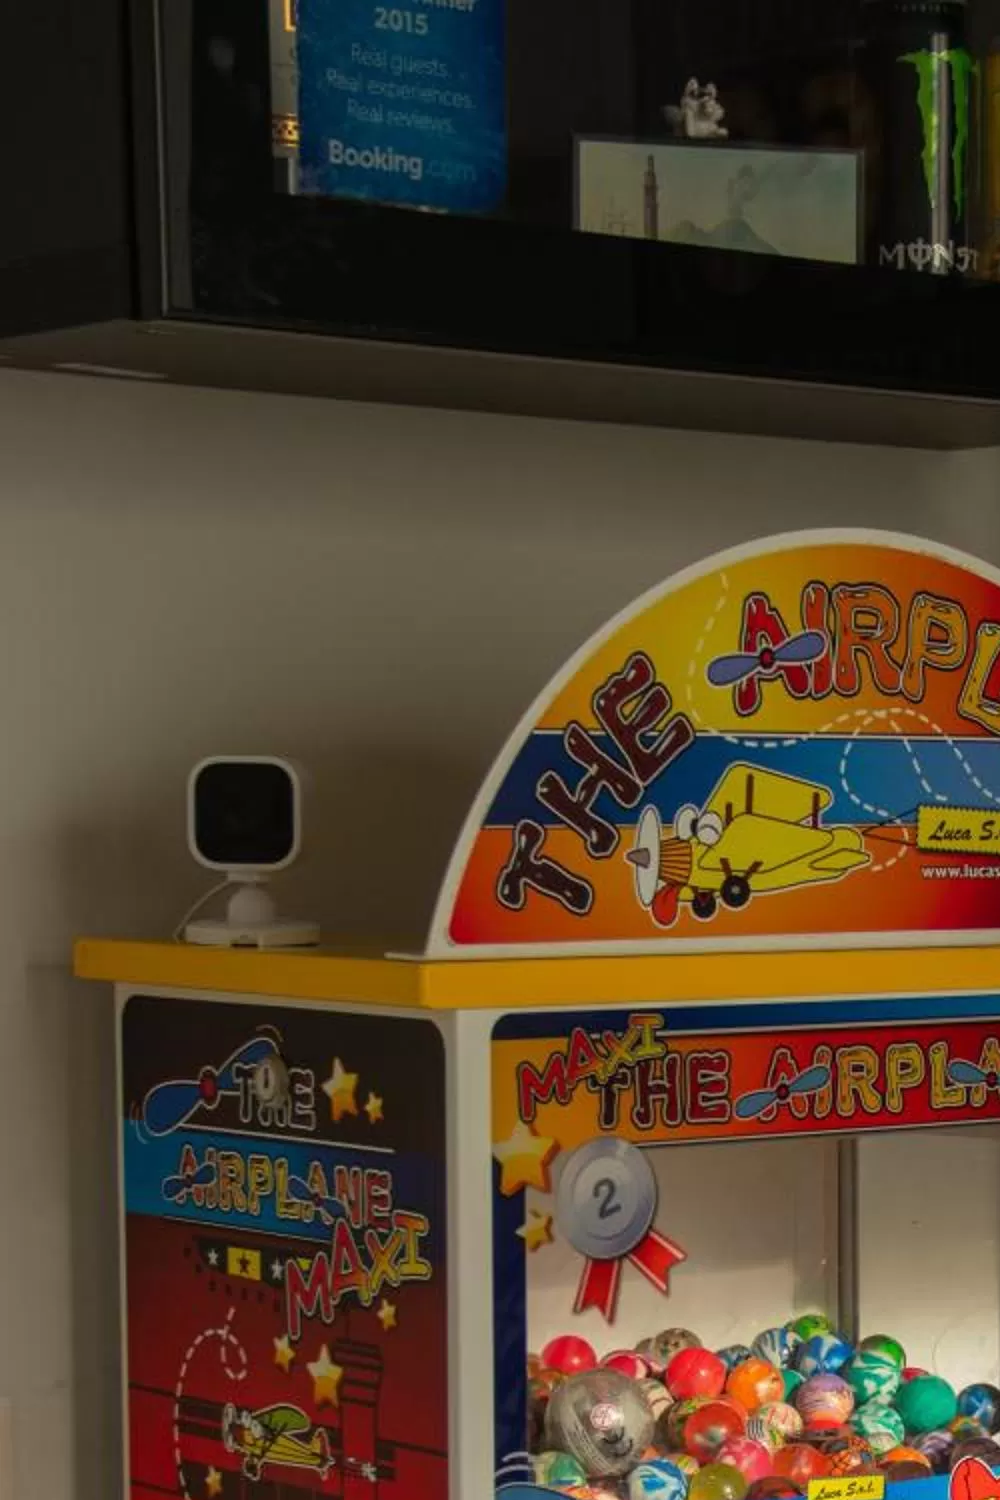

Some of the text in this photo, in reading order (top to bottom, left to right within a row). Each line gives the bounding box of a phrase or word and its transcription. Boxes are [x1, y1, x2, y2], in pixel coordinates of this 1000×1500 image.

[374, 6, 428, 36] 2015
[497, 650, 696, 915] THE
[928, 820, 973, 841] Luca
[516, 1012, 666, 1120] MAXI
[592, 1048, 732, 1130] THE
[163, 1144, 393, 1232] AIRPLANE
[592, 1177, 622, 1221] 2
[285, 1208, 433, 1341] MAXI
[815, 1486, 842, 1500] Luca
